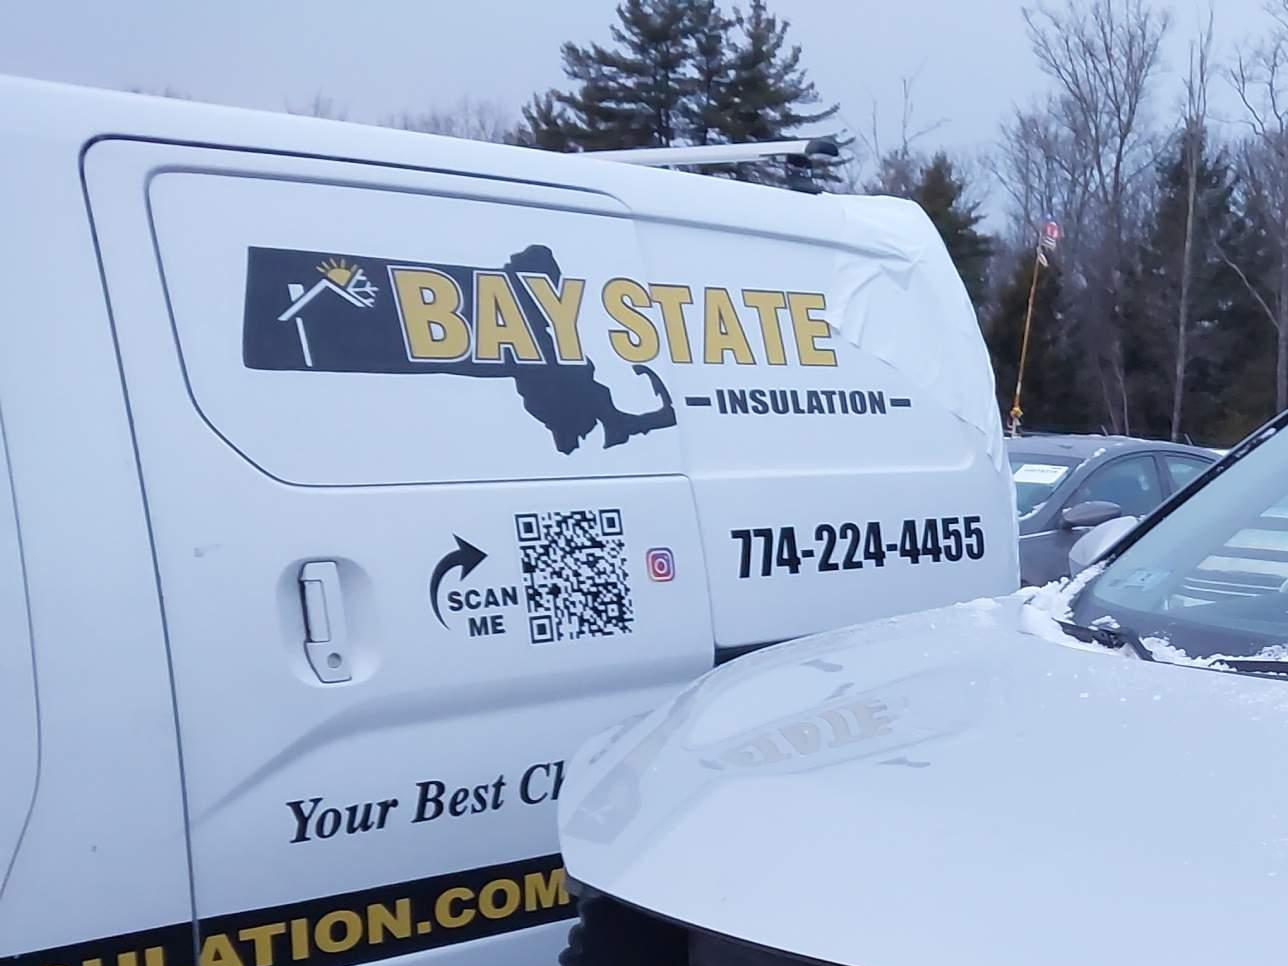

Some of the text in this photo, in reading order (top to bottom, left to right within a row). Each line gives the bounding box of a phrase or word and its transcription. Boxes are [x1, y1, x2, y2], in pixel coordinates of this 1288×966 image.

[386, 264, 838, 367] BAY STATE
[730, 515, 986, 580] 774-224-4455
[447, 587, 519, 613] SCAN
[468, 614, 506, 637] ME
[286, 797, 398, 844] Your
[411, 774, 506, 824] Best
